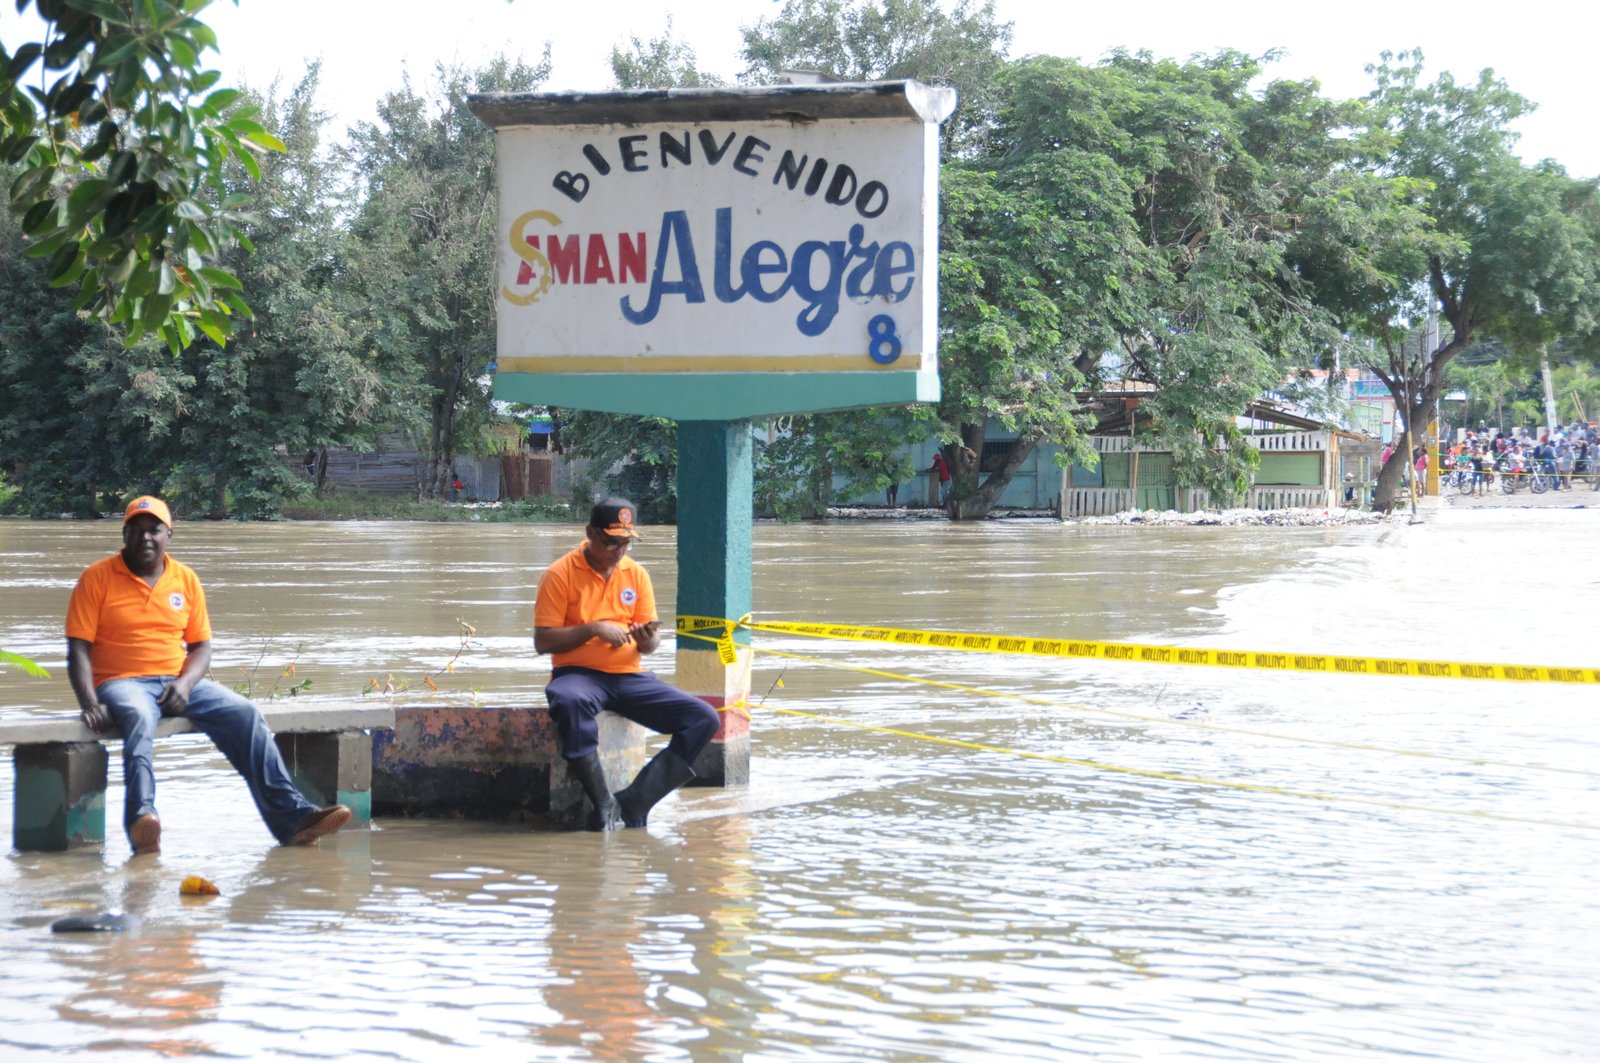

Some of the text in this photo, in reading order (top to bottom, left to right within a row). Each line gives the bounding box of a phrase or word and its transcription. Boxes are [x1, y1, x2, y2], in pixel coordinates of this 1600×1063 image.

[552, 129, 889, 219] BIENVENIDO
[620, 206, 915, 337] Alegre
[867, 314, 902, 364] 8
[895, 632, 923, 644] CAUTION
[928, 634, 957, 647] CAUTION
[961, 636, 991, 649] CAUTION
[997, 638, 1026, 652] CAUTION
[1032, 640, 1061, 655] CAUTION
[1067, 643, 1097, 657] CAUTION
[1104, 645, 1134, 659] CAUTION
[1141, 647, 1170, 662] CAUTION
[1178, 649, 1208, 664] CAUTION
[1216, 652, 1247, 666] CAUTION
[1255, 654, 1286, 668] CAUTION
[1294, 656, 1326, 670] CAUTION
[1334, 658, 1367, 672] CAUTION
[1376, 660, 1409, 675] CAUTION
[1417, 662, 1451, 677] CAUTION
[1460, 664, 1495, 679] CAUTION
[1504, 666, 1540, 681] CAUTION
[1548, 668, 1585, 683] CAUTION
